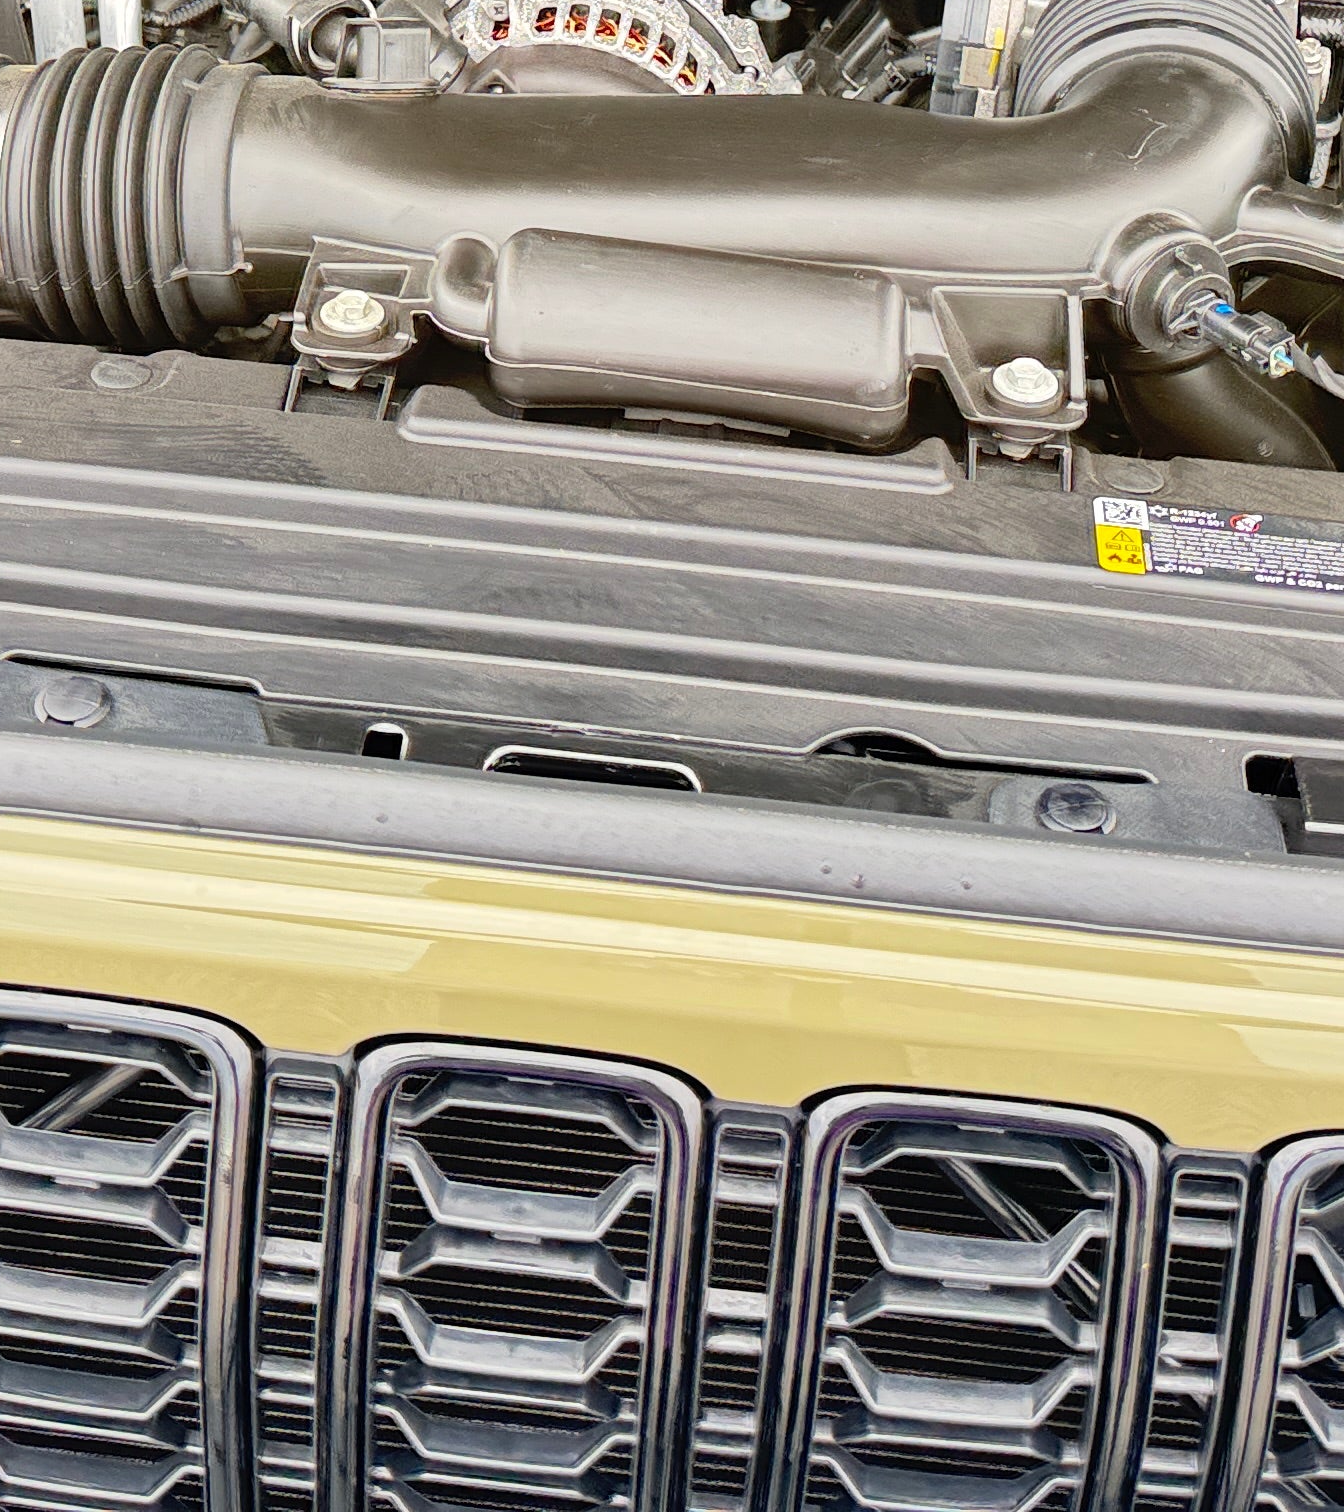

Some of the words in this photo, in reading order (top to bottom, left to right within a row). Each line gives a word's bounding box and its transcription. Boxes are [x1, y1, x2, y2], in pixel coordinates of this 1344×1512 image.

[1179, 565, 1204, 575] PAG
[1254, 574, 1284, 584] GWP
[1325, 582, 1344, 591] per
